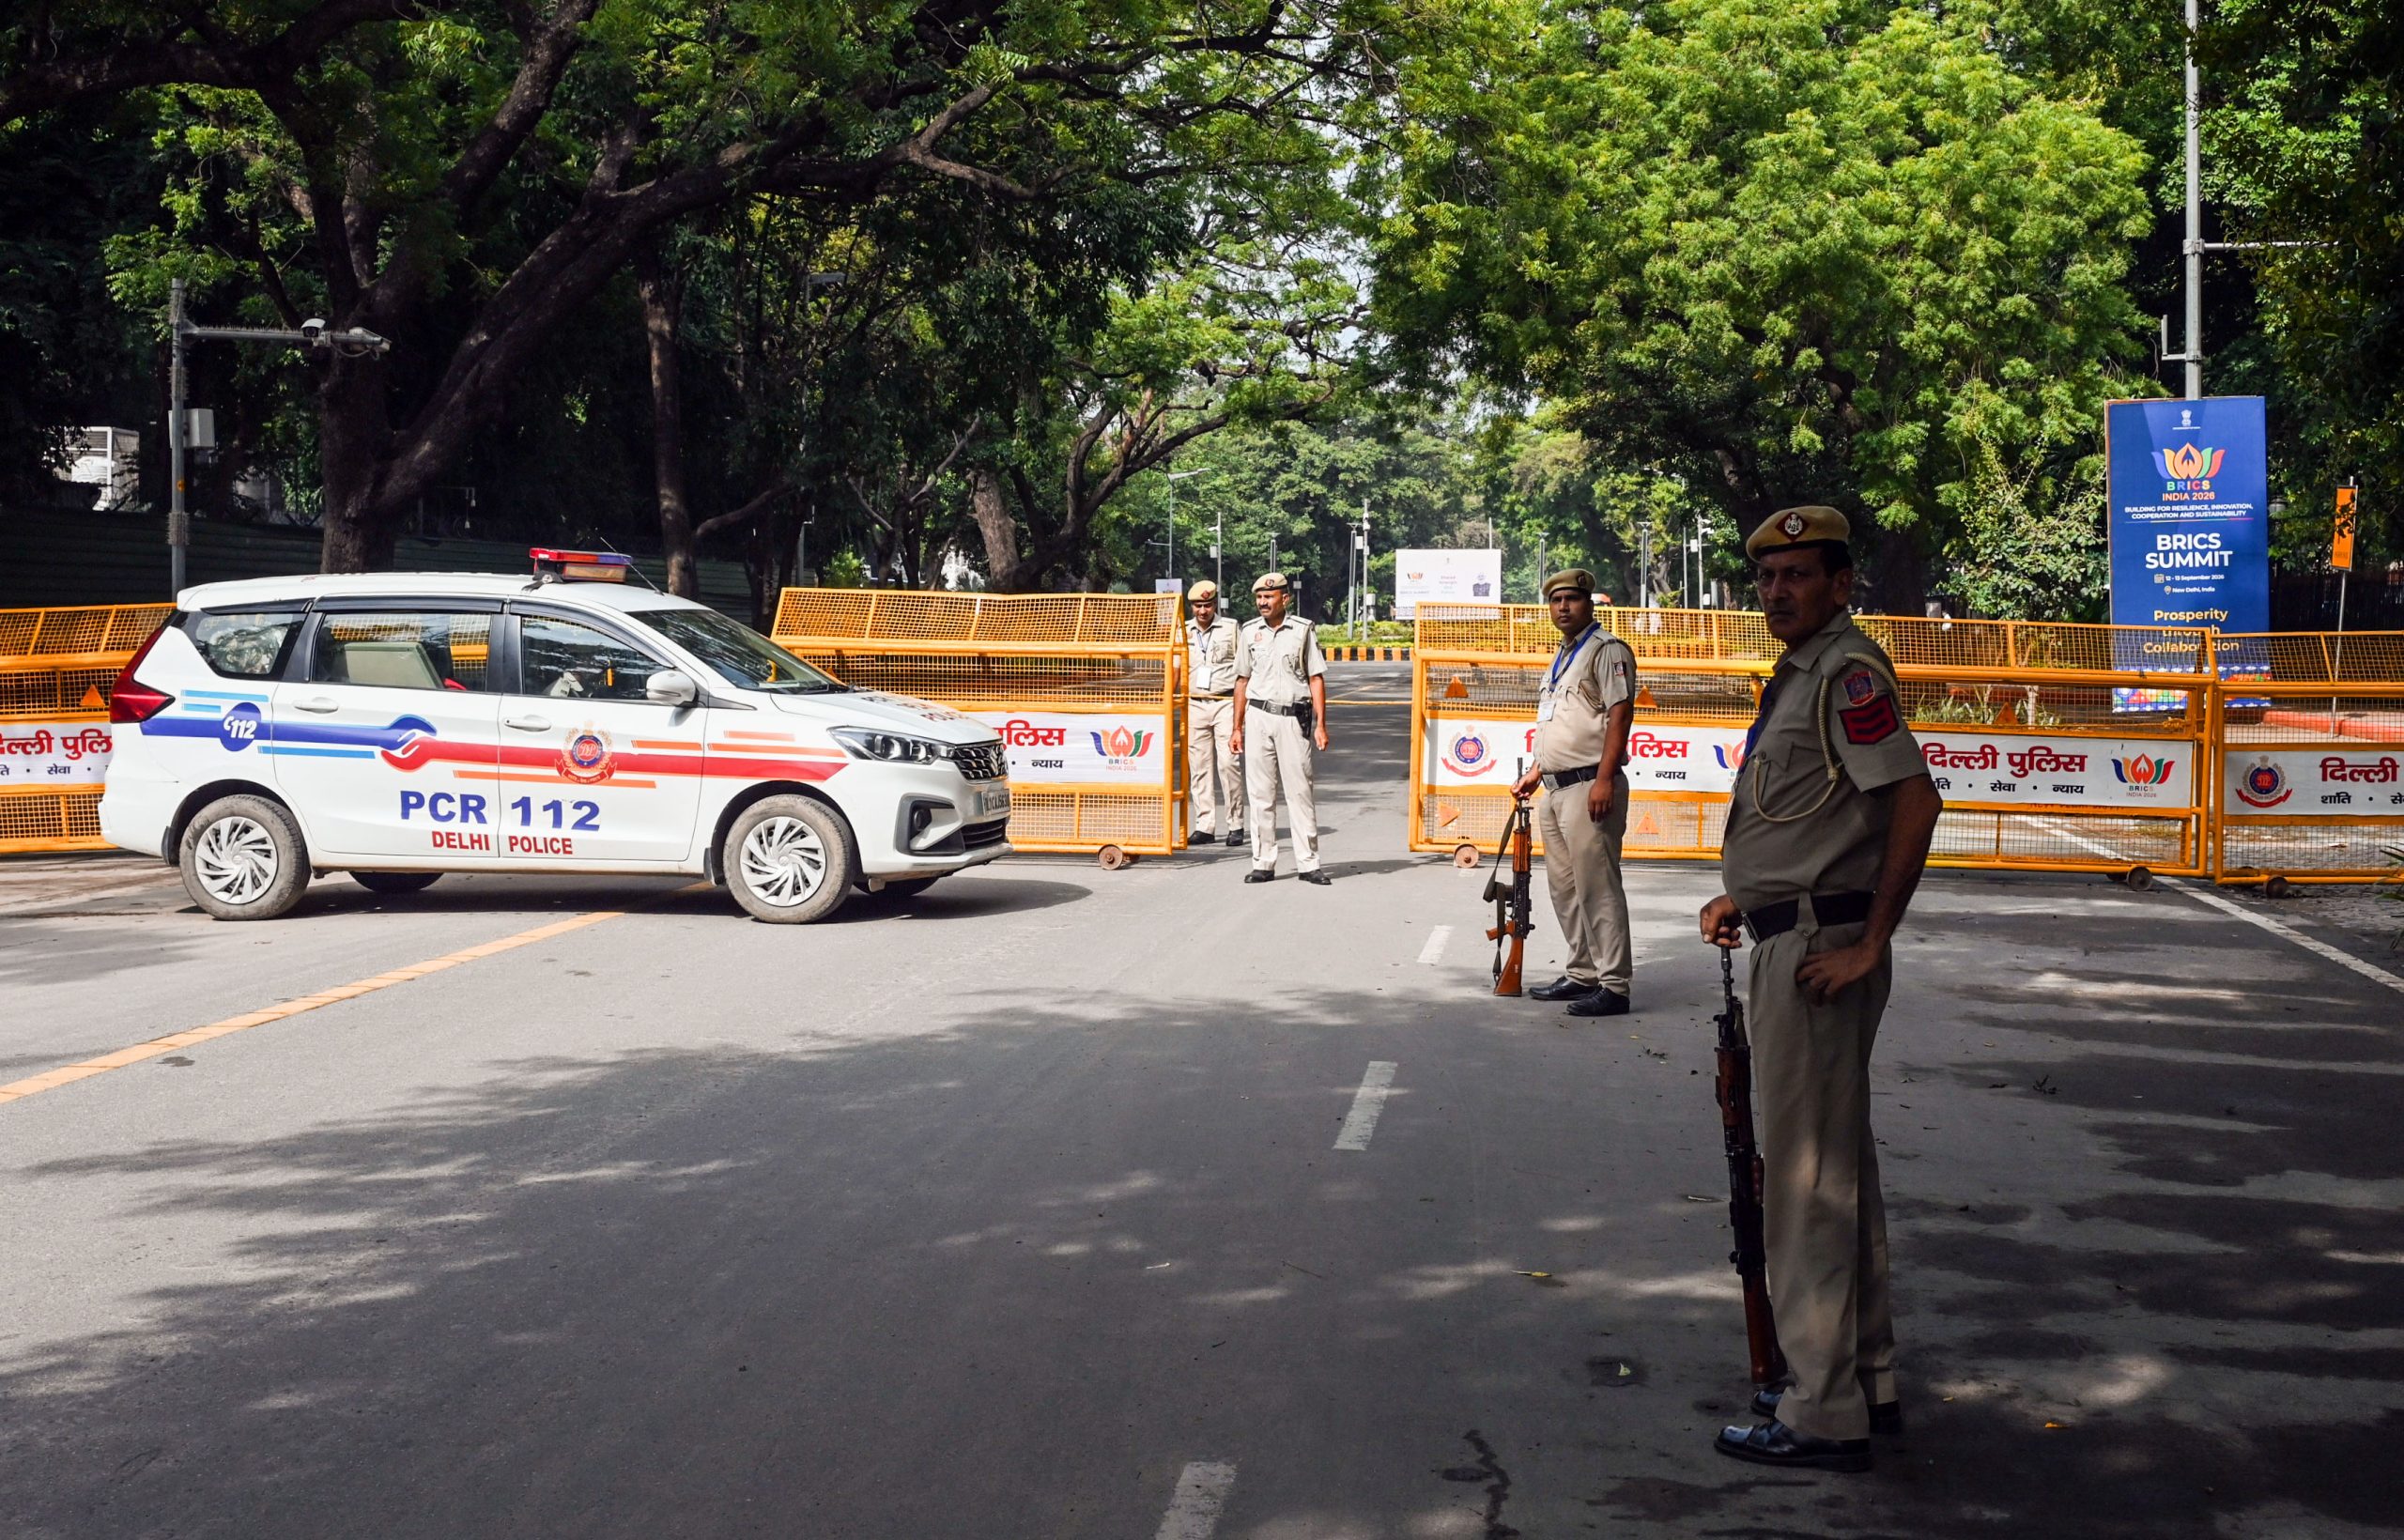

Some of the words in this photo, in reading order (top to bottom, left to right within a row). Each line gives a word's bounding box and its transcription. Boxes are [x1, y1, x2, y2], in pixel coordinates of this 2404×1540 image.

[2166, 480, 2211, 491] BRICS
[2162, 492, 2190, 501] INDIA
[2192, 491, 2215, 500] 2026
[2156, 532, 2222, 551] BRICS
[2145, 551, 2234, 569] SUMMIT
[2154, 608, 2228, 623] Prosperity
[0, 730, 54, 755] ल्ली
[47, 762, 71, 776] सेवा
[1031, 759, 1063, 768] न्याय
[2007, 746, 2088, 778] पुलिस
[1655, 771, 1687, 780] न्याय
[2319, 757, 2399, 783] दिल्ली
[1990, 779, 2016, 792] सेवा
[2052, 783, 2085, 794] न्याय
[2321, 792, 2351, 805] शांति
[400, 790, 487, 824] PCR
[511, 796, 600, 832] 112
[431, 830, 491, 851] DELHI
[508, 835, 574, 855] POLICE
